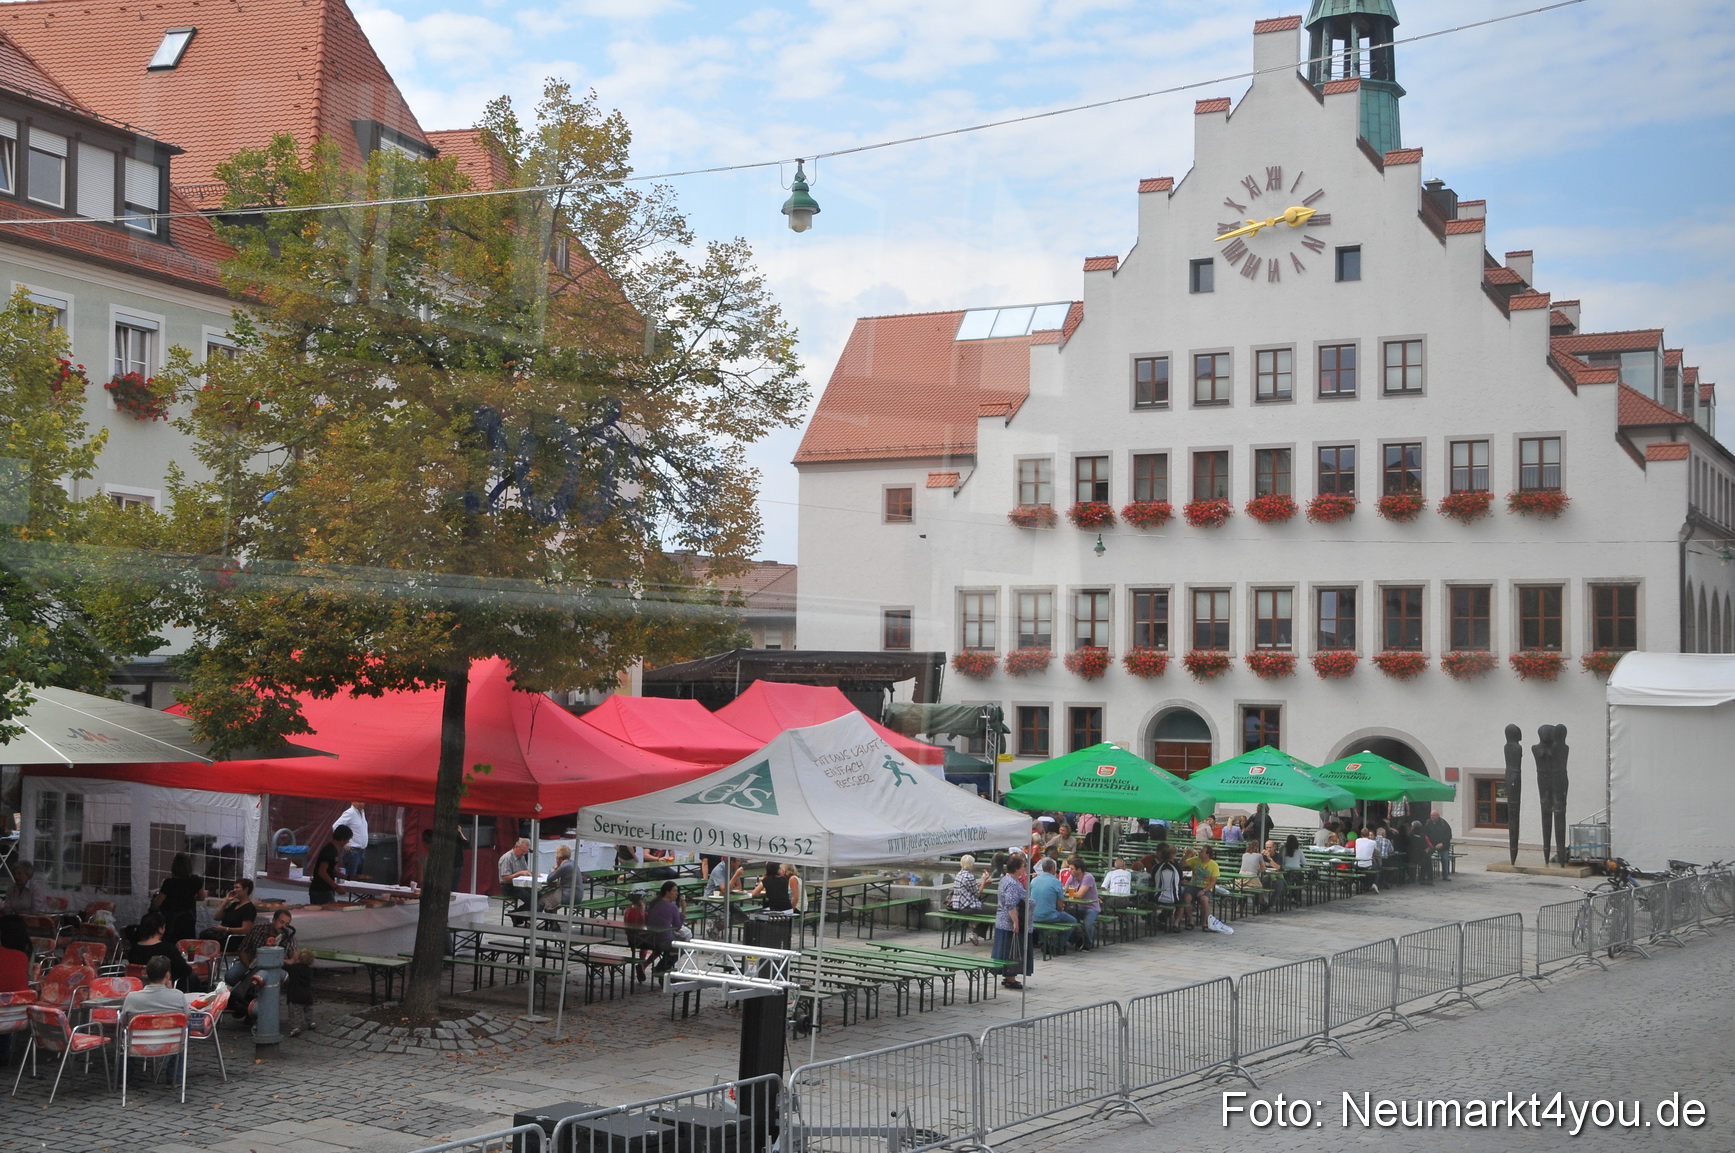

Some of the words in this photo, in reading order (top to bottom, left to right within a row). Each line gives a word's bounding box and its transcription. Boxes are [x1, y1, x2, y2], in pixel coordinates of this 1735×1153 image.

[1063, 779, 1140, 791] Lammsbräu
[594, 814, 688, 843] Service-Line:
[693, 827, 703, 845] 0
[708, 828, 726, 847] 91
[732, 832, 750, 850] 81
[768, 836, 788, 855] 63
[794, 838, 813, 856] 52
